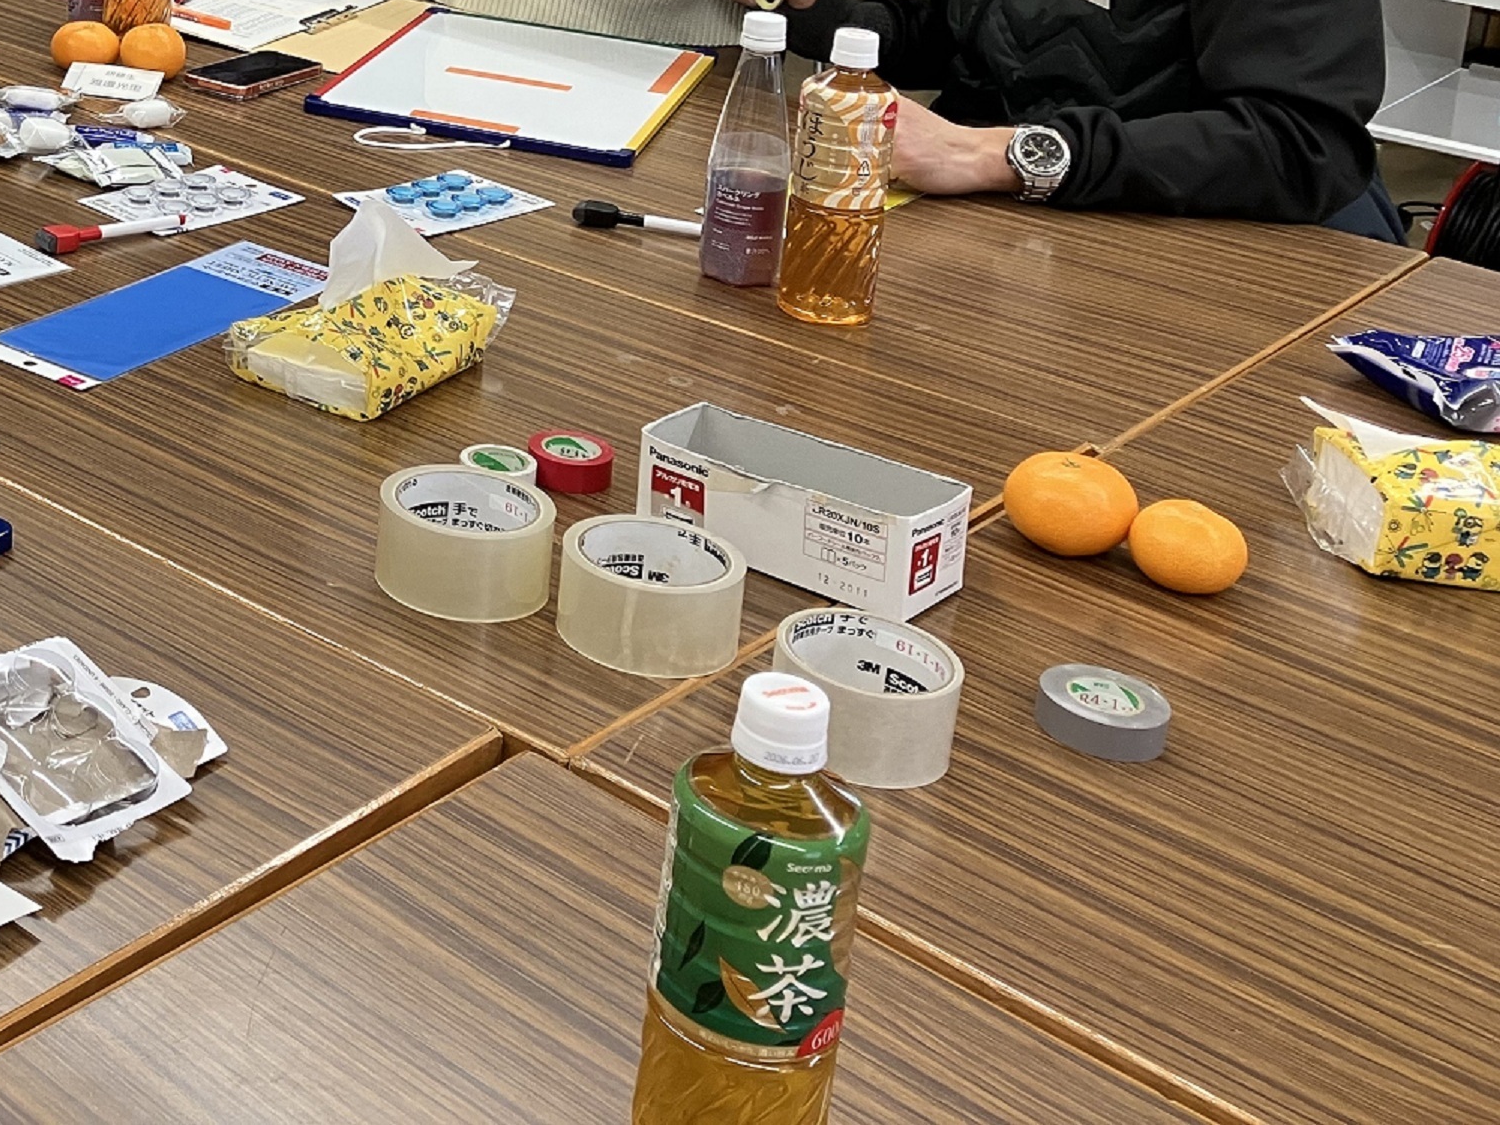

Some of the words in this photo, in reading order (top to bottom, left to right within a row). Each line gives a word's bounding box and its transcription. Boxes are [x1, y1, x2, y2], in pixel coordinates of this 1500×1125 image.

[649, 445, 710, 478] Panasonic
[453, 502, 479, 519] 手で
[647, 569, 670, 583] 3M
[856, 659, 882, 675] 3M
[747, 879, 838, 1024] 濃茶
